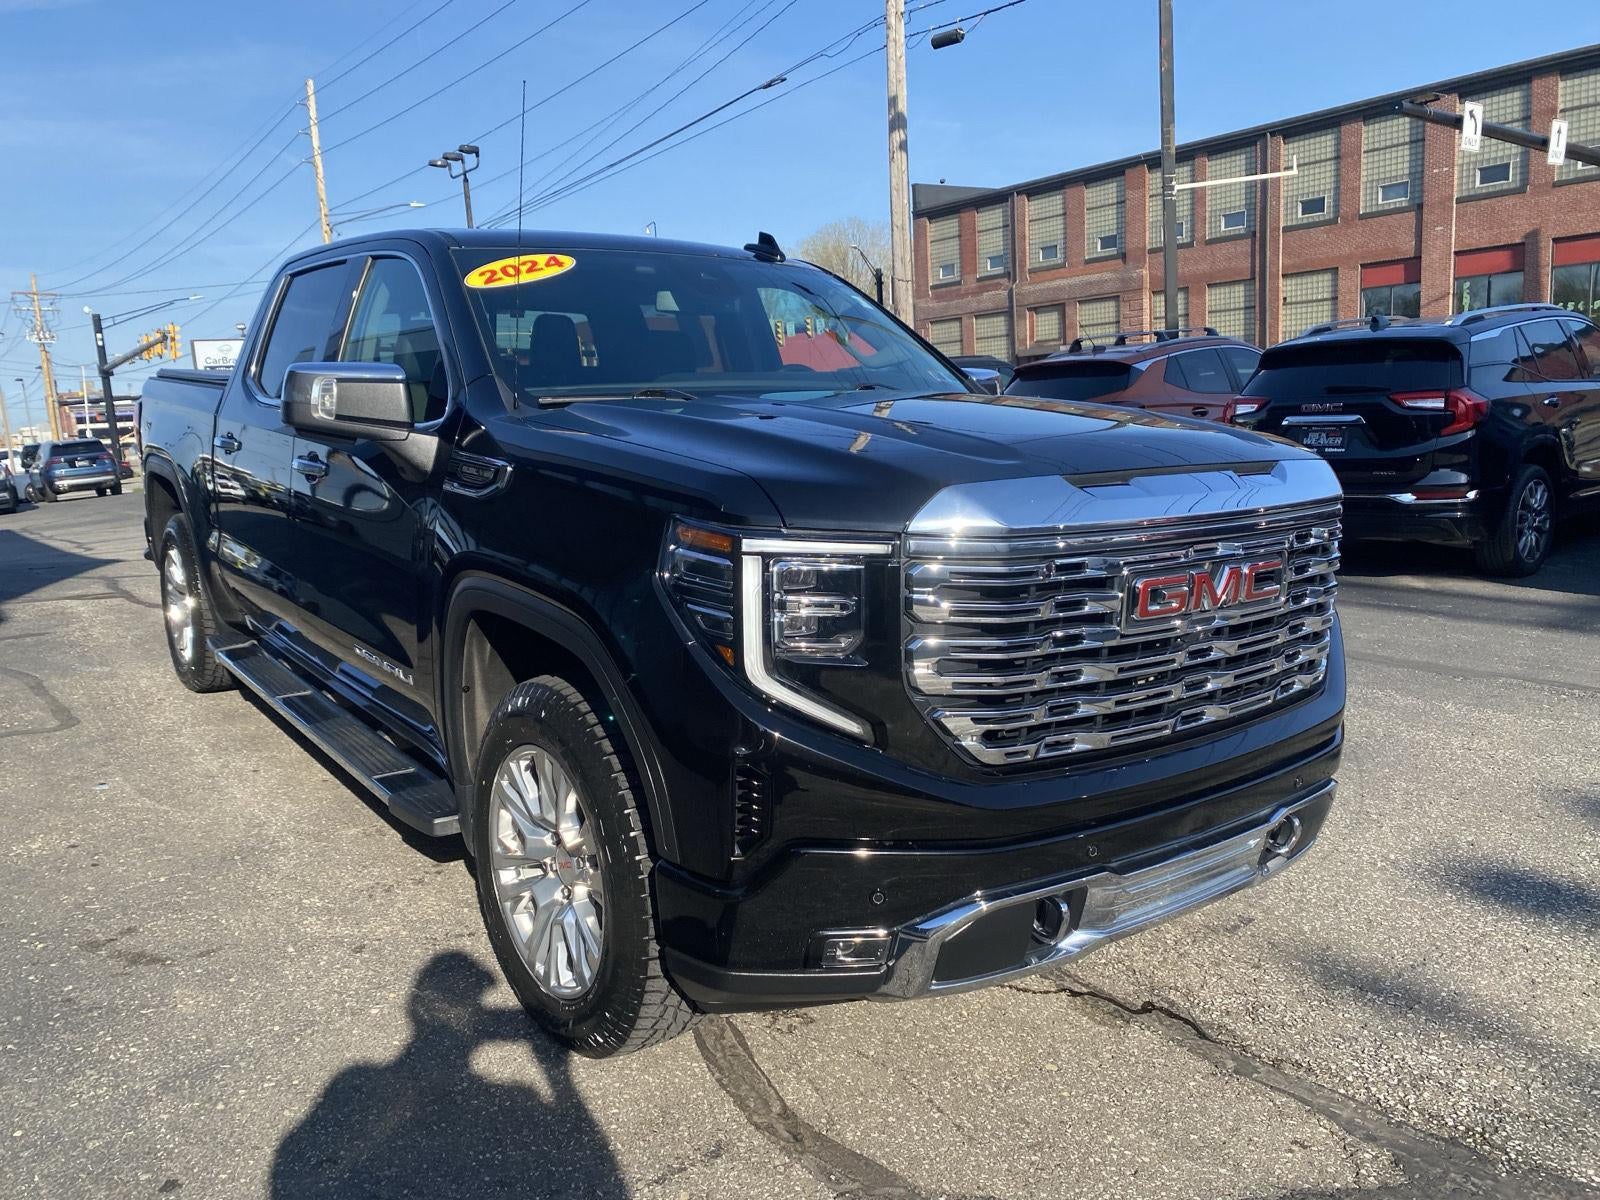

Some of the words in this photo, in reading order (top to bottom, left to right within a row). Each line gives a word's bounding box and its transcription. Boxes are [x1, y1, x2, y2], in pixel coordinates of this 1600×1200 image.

[1464, 136, 1478, 147] ONLY
[478, 256, 566, 285] 2024
[1301, 403, 1343, 412] GMC
[1303, 436, 1343, 445] WEAVER
[1136, 559, 1283, 619] GMC
